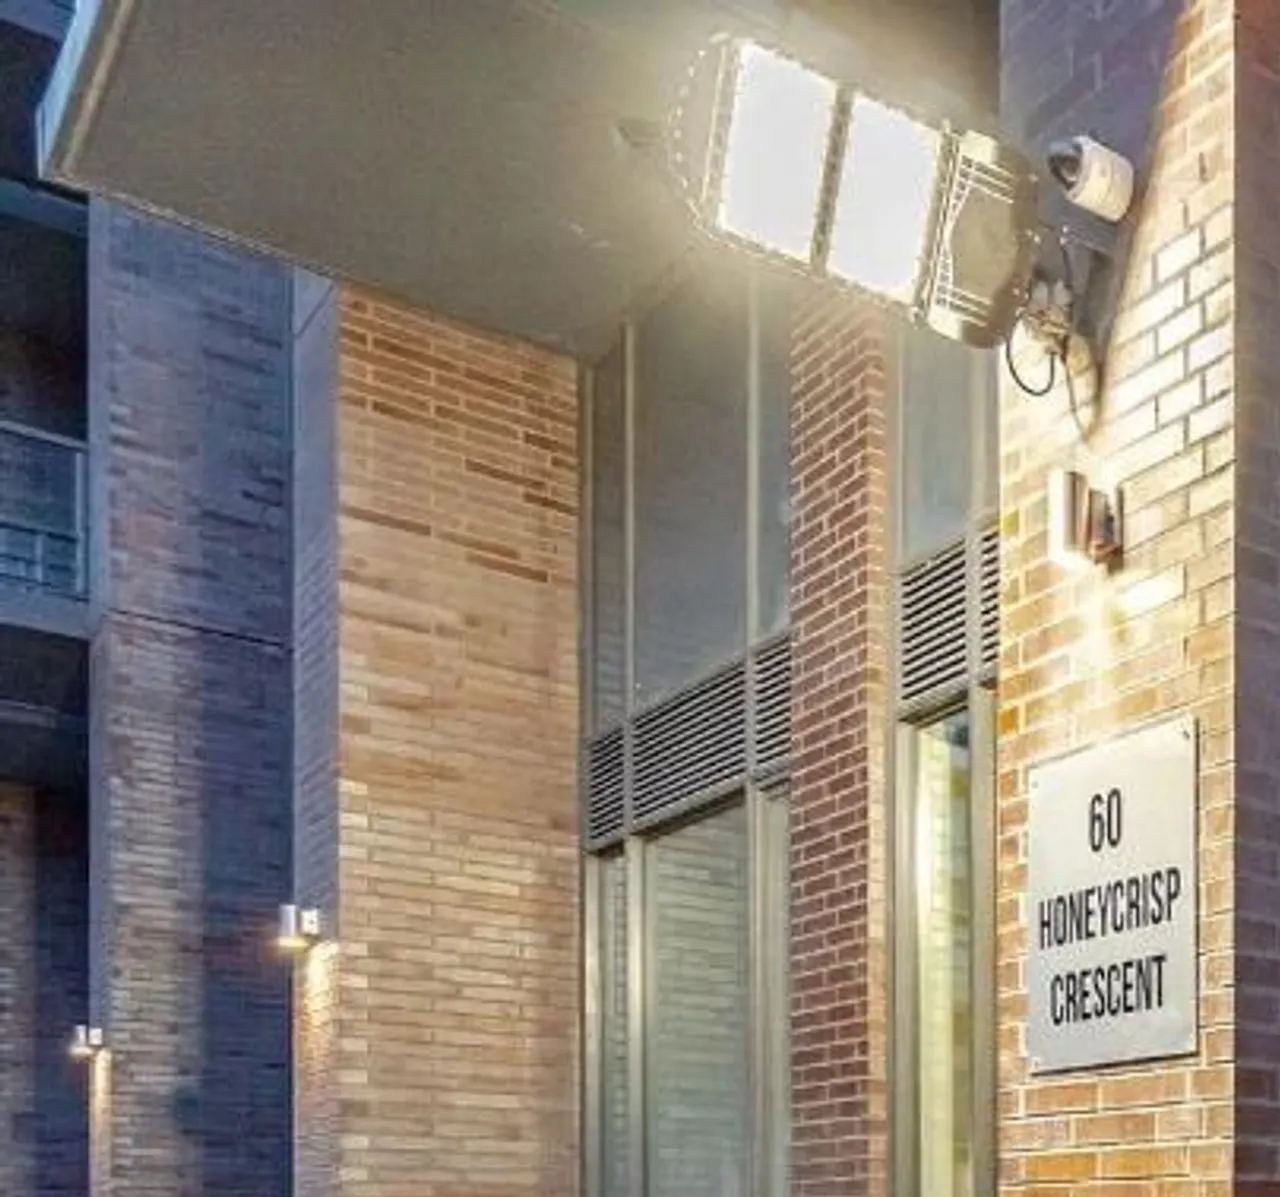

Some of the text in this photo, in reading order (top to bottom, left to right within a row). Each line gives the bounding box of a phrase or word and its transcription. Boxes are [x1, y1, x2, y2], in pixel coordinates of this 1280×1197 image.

[1088, 787, 1122, 852] 60
[1038, 867, 1181, 950] HONEYCRISP
[1050, 955, 1167, 1026] CRESCENT
